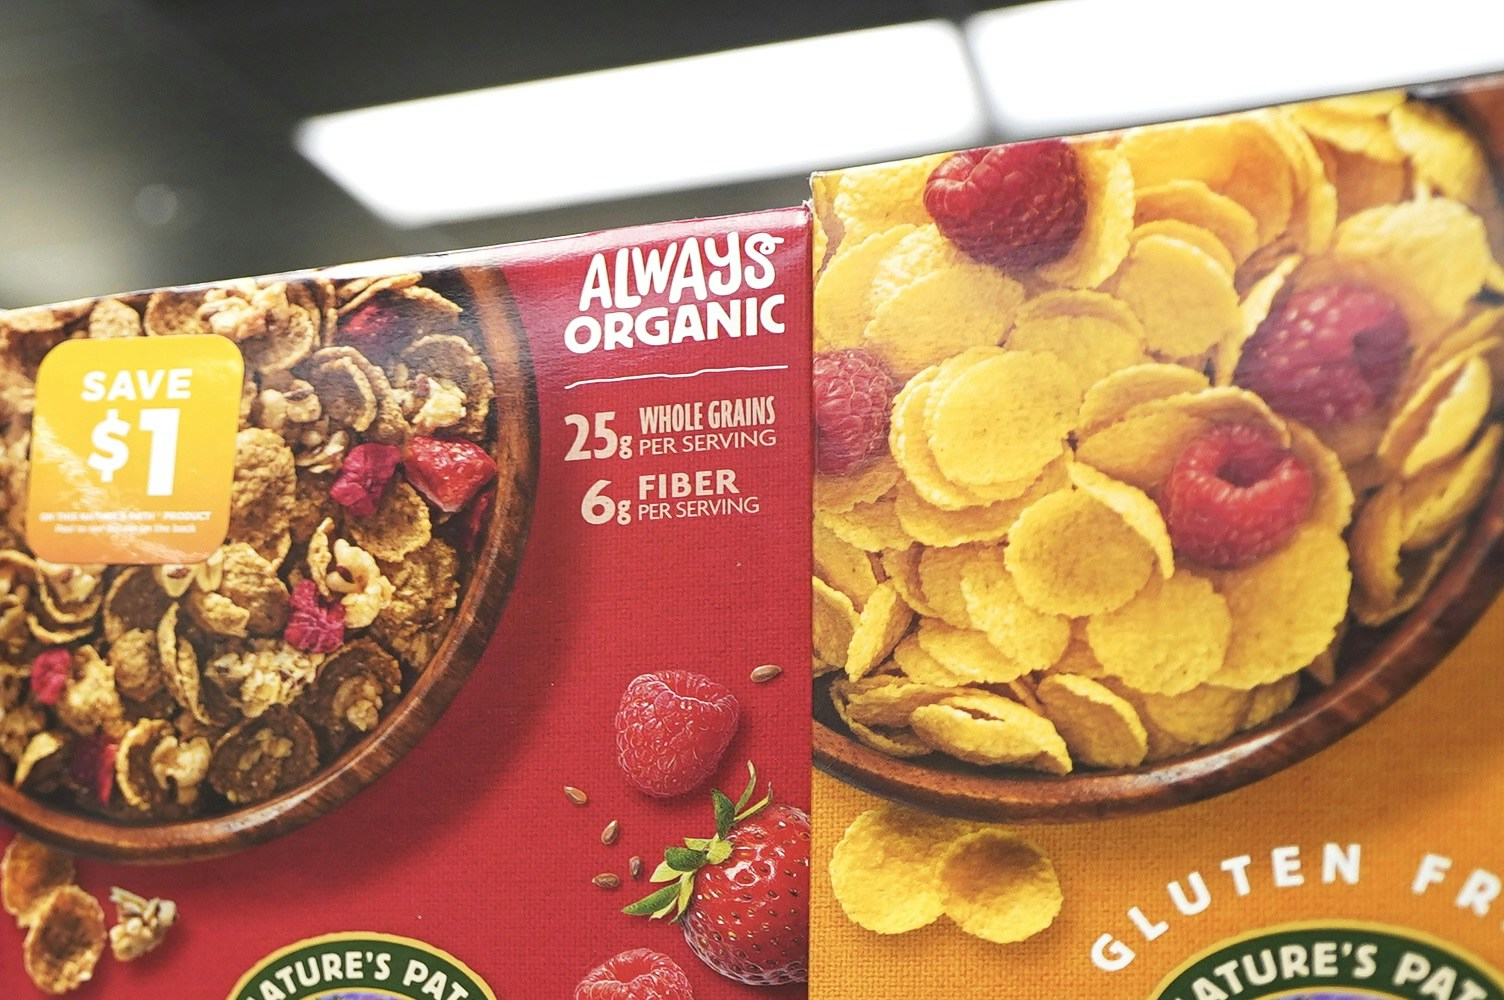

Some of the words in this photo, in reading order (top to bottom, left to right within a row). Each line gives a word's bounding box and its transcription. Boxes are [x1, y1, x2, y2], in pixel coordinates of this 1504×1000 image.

[578, 231, 784, 311] ALWAYS
[563, 294, 785, 354] ORGANIC
[81, 368, 193, 402] SAVE
[87, 408, 180, 496] $1
[564, 411, 633, 461] 25g
[639, 402, 703, 434] WHOLE
[708, 395, 776, 429] GRAINS
[639, 436, 678, 456] PER
[682, 428, 777, 452] SERVING
[580, 479, 632, 525] 6g
[638, 468, 740, 500] FIBER
[638, 503, 673, 521] PER
[676, 496, 760, 518] SERVING
[1090, 842, 1362, 973] GLUTEN
[1411, 853, 1504, 935] FR
